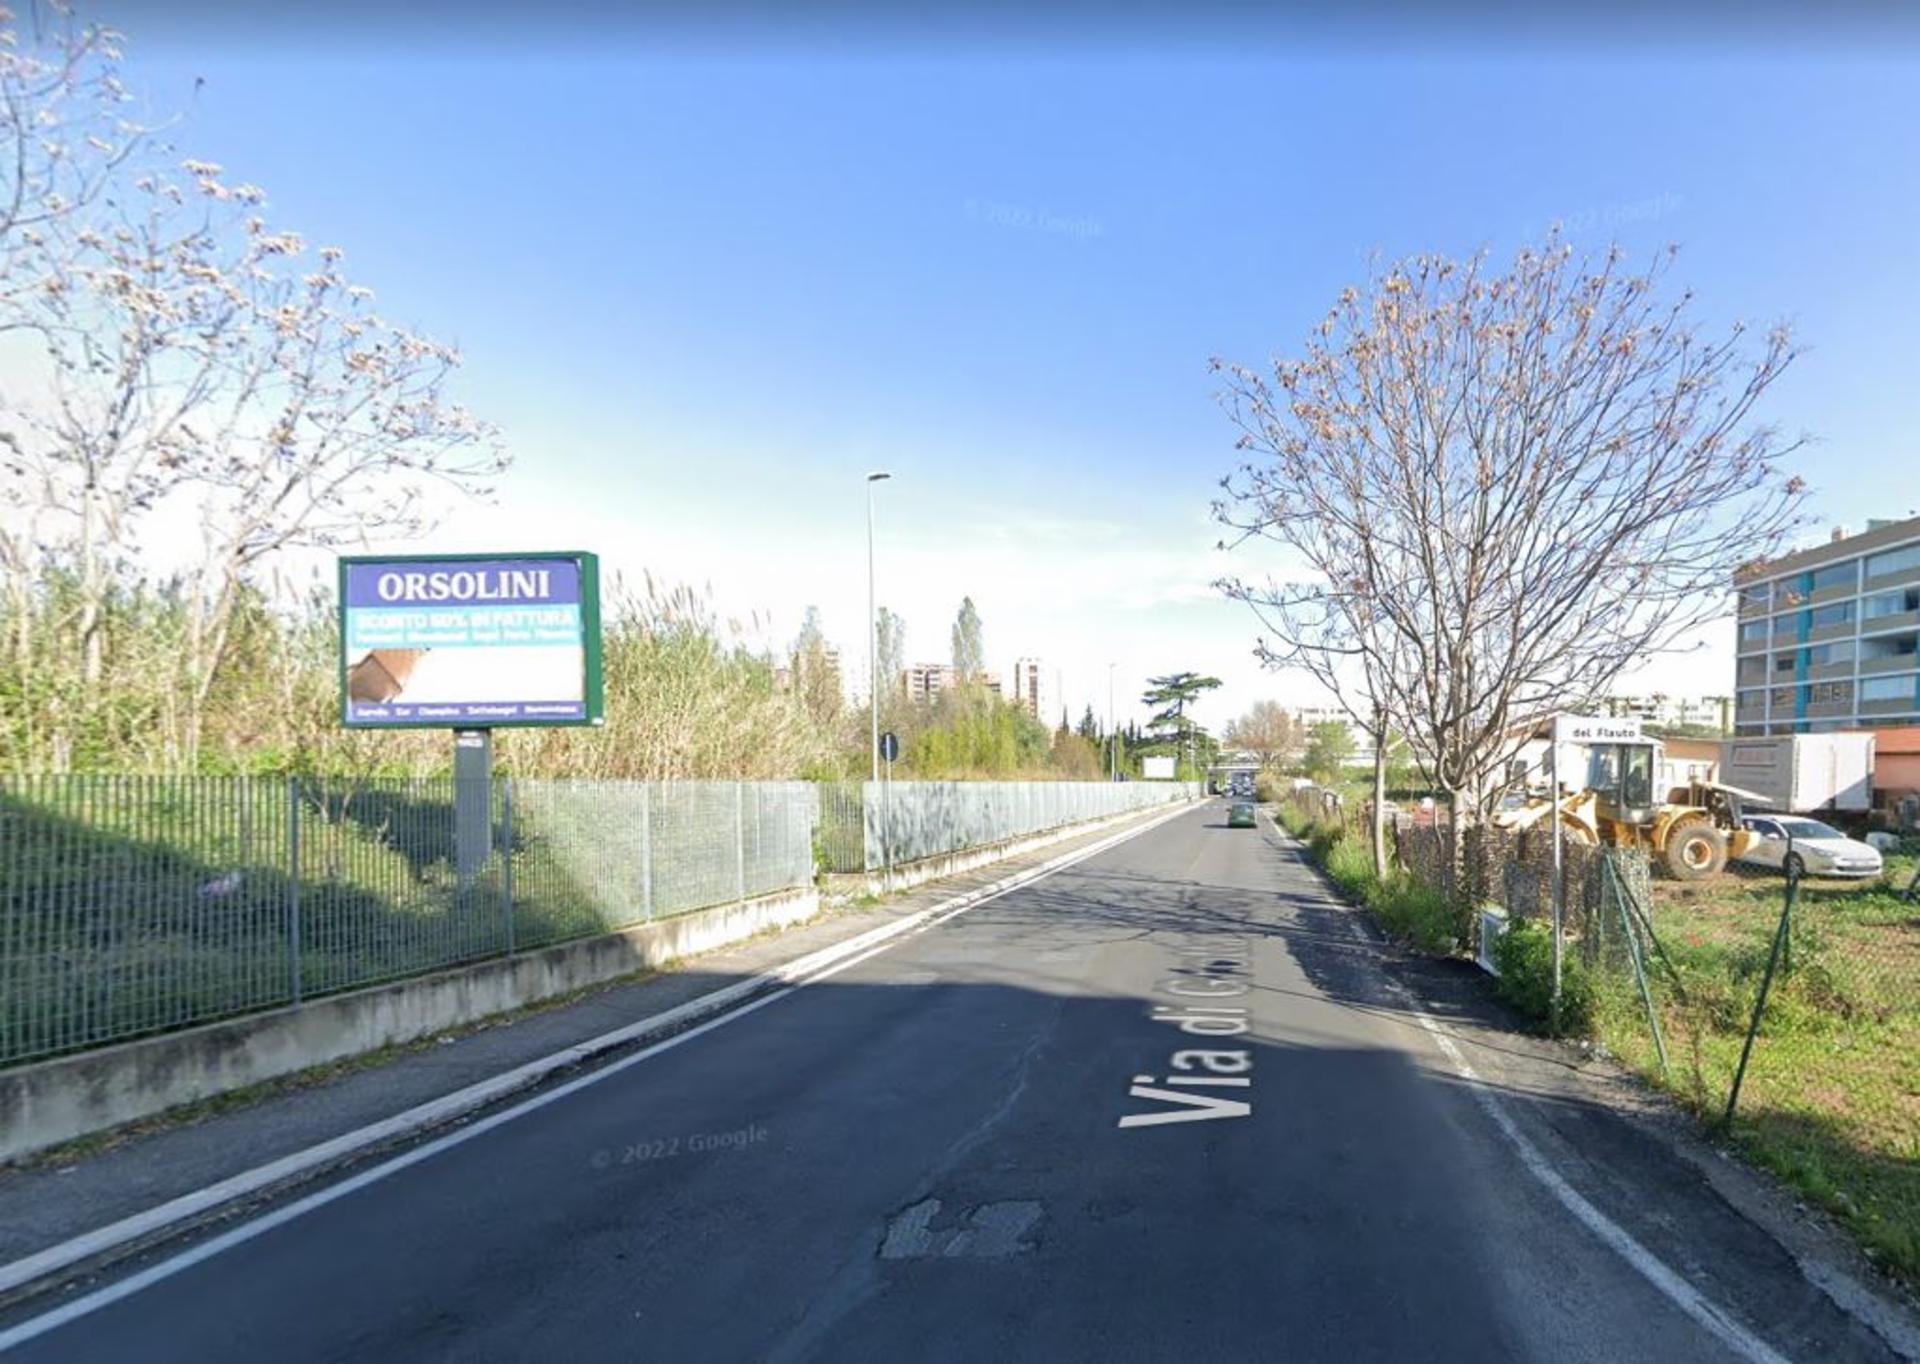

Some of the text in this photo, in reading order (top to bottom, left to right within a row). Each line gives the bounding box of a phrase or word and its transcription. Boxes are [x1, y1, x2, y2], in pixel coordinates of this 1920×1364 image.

[378, 570, 550, 601] ORSOLINI
[1572, 727, 1636, 738] del Flauto
